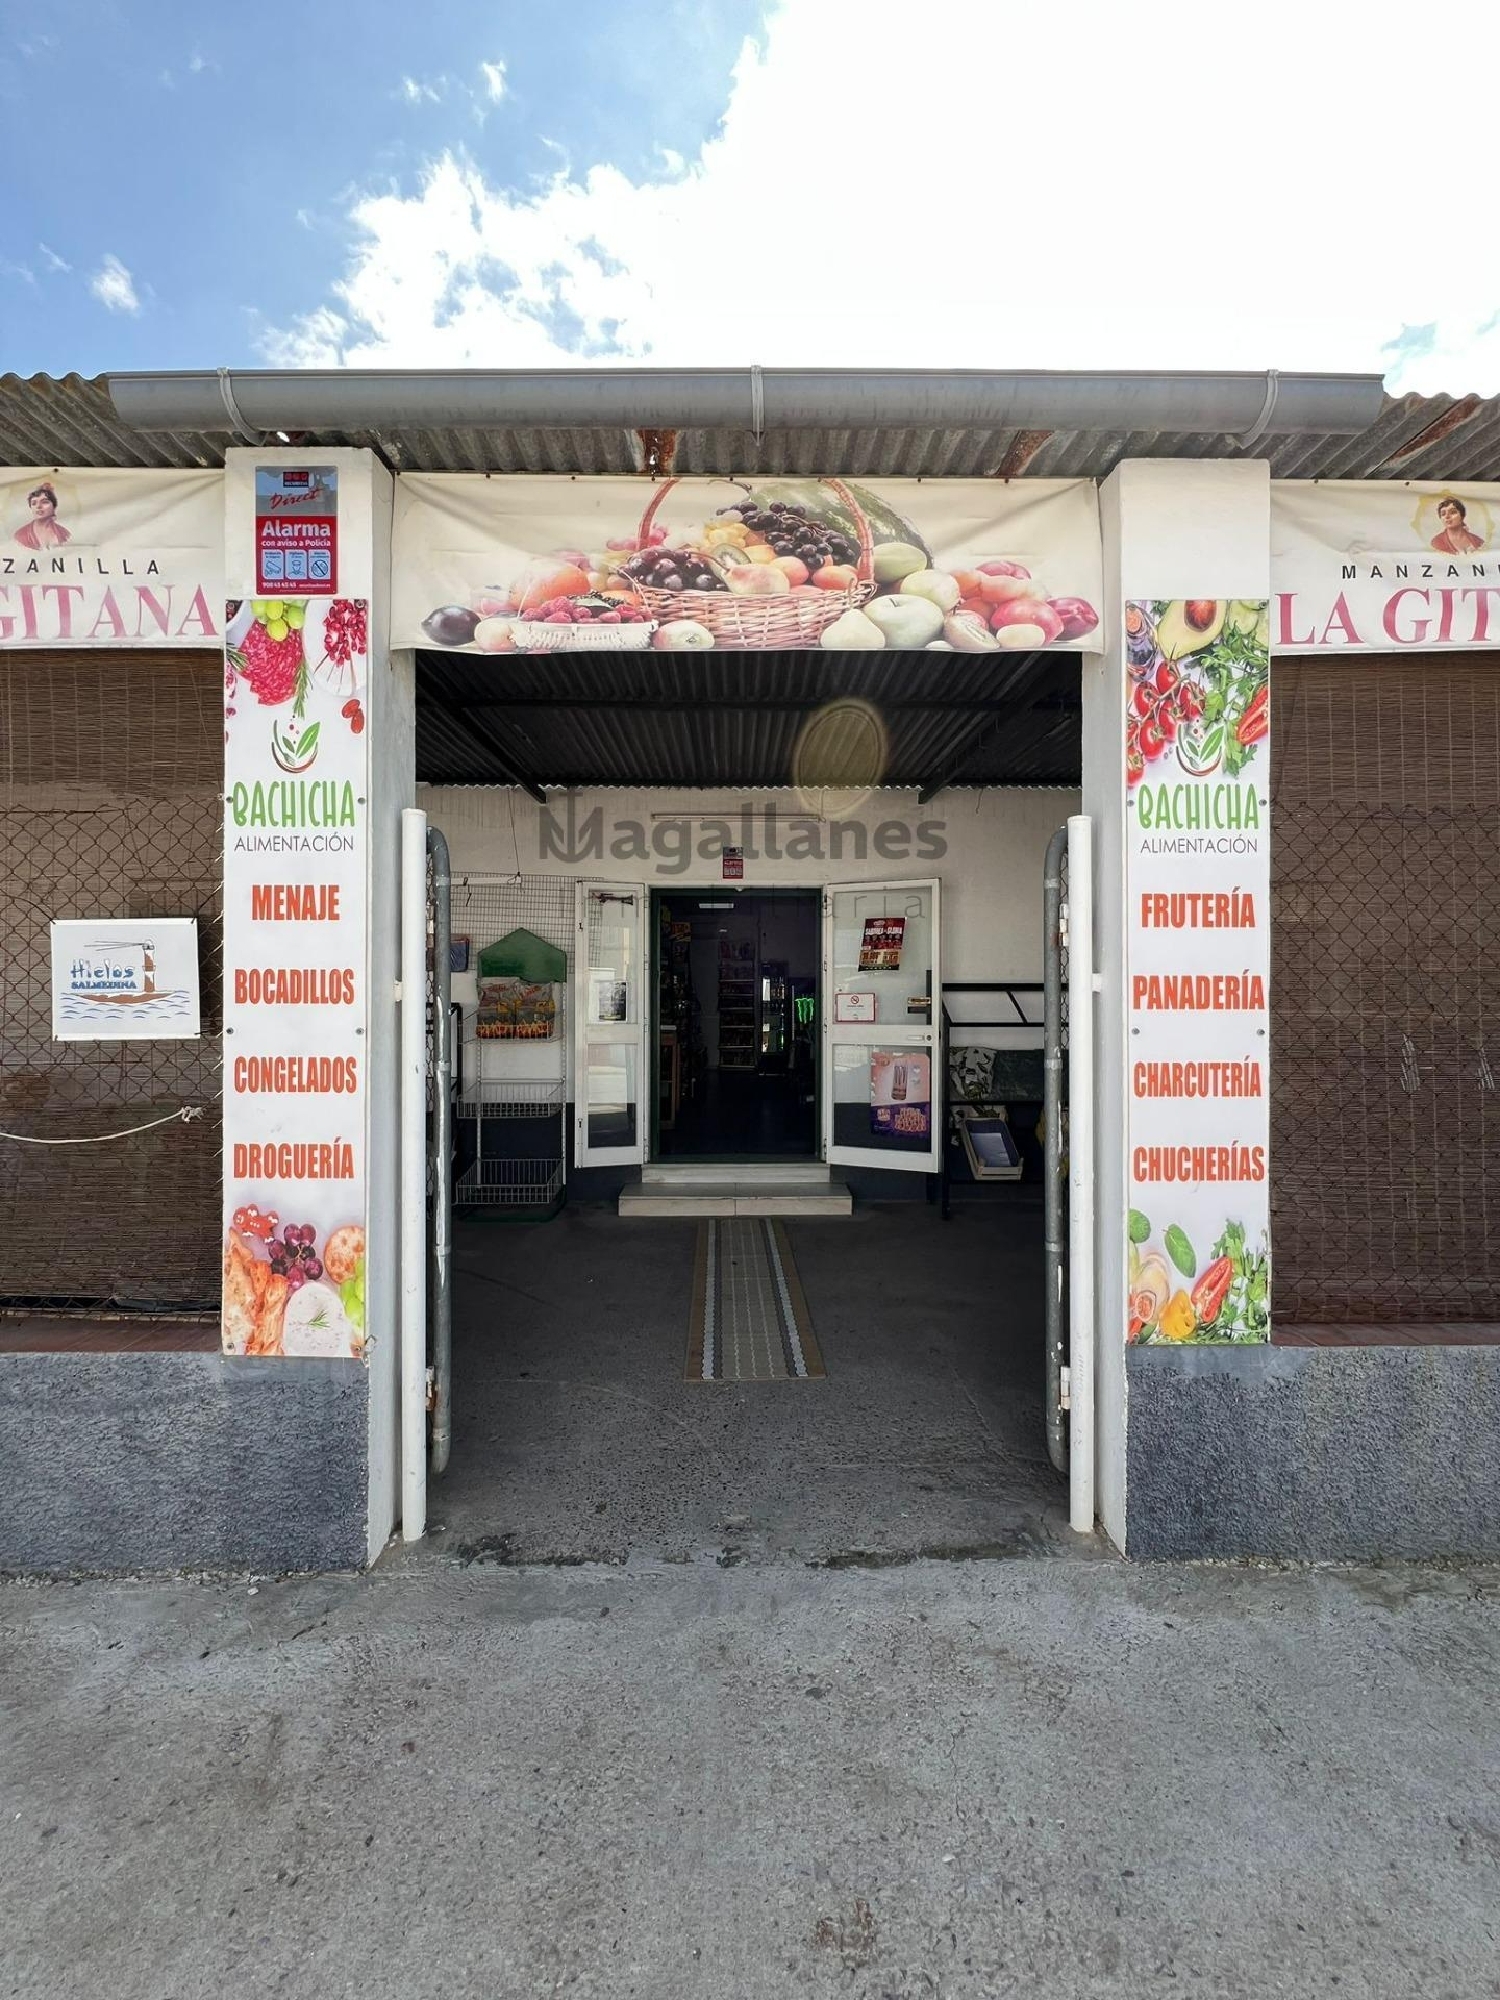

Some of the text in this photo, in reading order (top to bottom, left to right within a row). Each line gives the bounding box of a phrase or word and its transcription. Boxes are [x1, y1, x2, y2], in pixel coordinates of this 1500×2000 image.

[262, 519, 331, 537] Alarma
[277, 539, 298, 547] aviso
[1275, 587, 1500, 645] LA GIT
[232, 780, 355, 827] BACHICHA
[1138, 783, 1259, 830] BACHICHA
[234, 832, 354, 852] ALIMENTACIÓN
[1140, 834, 1258, 854] ALIMENTACIÓN
[251, 884, 340, 921] MENAJE
[1141, 886, 1256, 928] FRUTERÍA
[71, 958, 134, 979] Hielos
[234, 968, 355, 1005] BOCADILLOS
[1132, 969, 1265, 1010] PANADERÍA
[234, 1056, 357, 1093] CONGELADOS
[1133, 1055, 1261, 1098] CHARCUTERÍA
[233, 1136, 354, 1179] DROGUERÍA
[1133, 1140, 1265, 1182] CHUCHERÍAS
